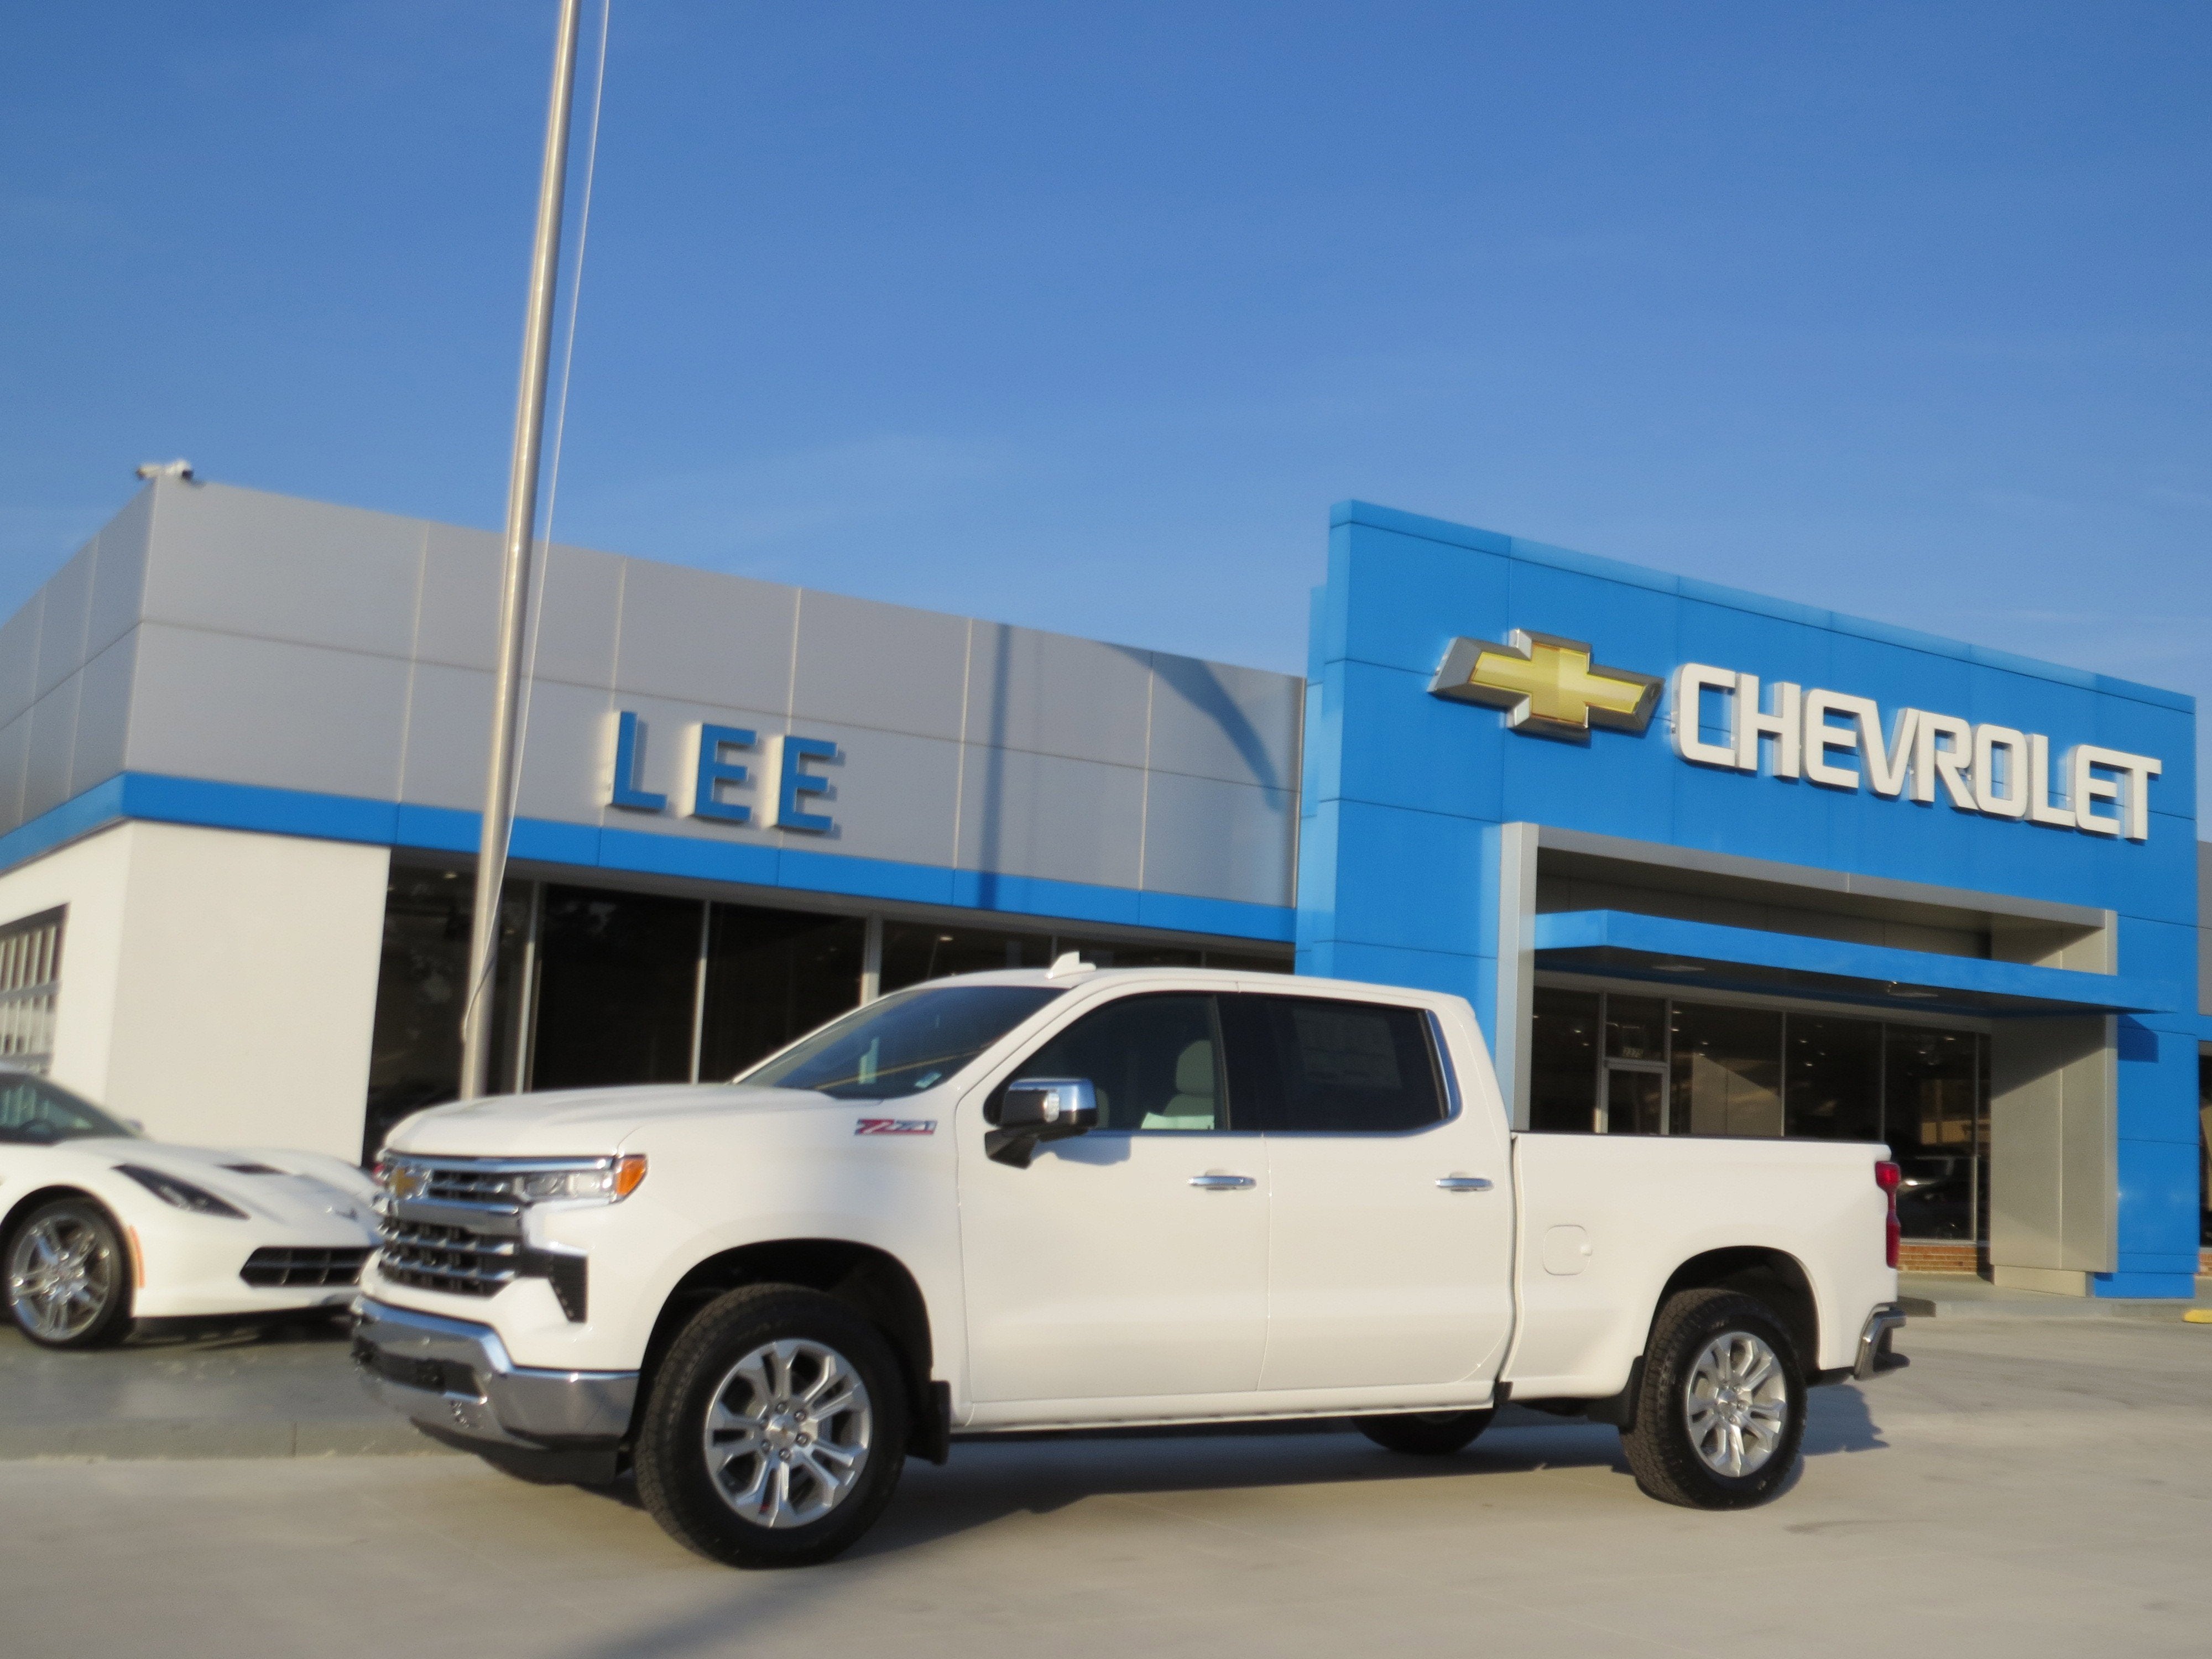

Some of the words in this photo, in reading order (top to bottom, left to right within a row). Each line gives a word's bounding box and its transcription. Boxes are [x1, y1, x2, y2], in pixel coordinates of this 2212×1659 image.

[608, 710, 838, 830] LEE
[1673, 662, 2162, 841] CHEVROLET
[854, 1118, 938, 1135] Z71
